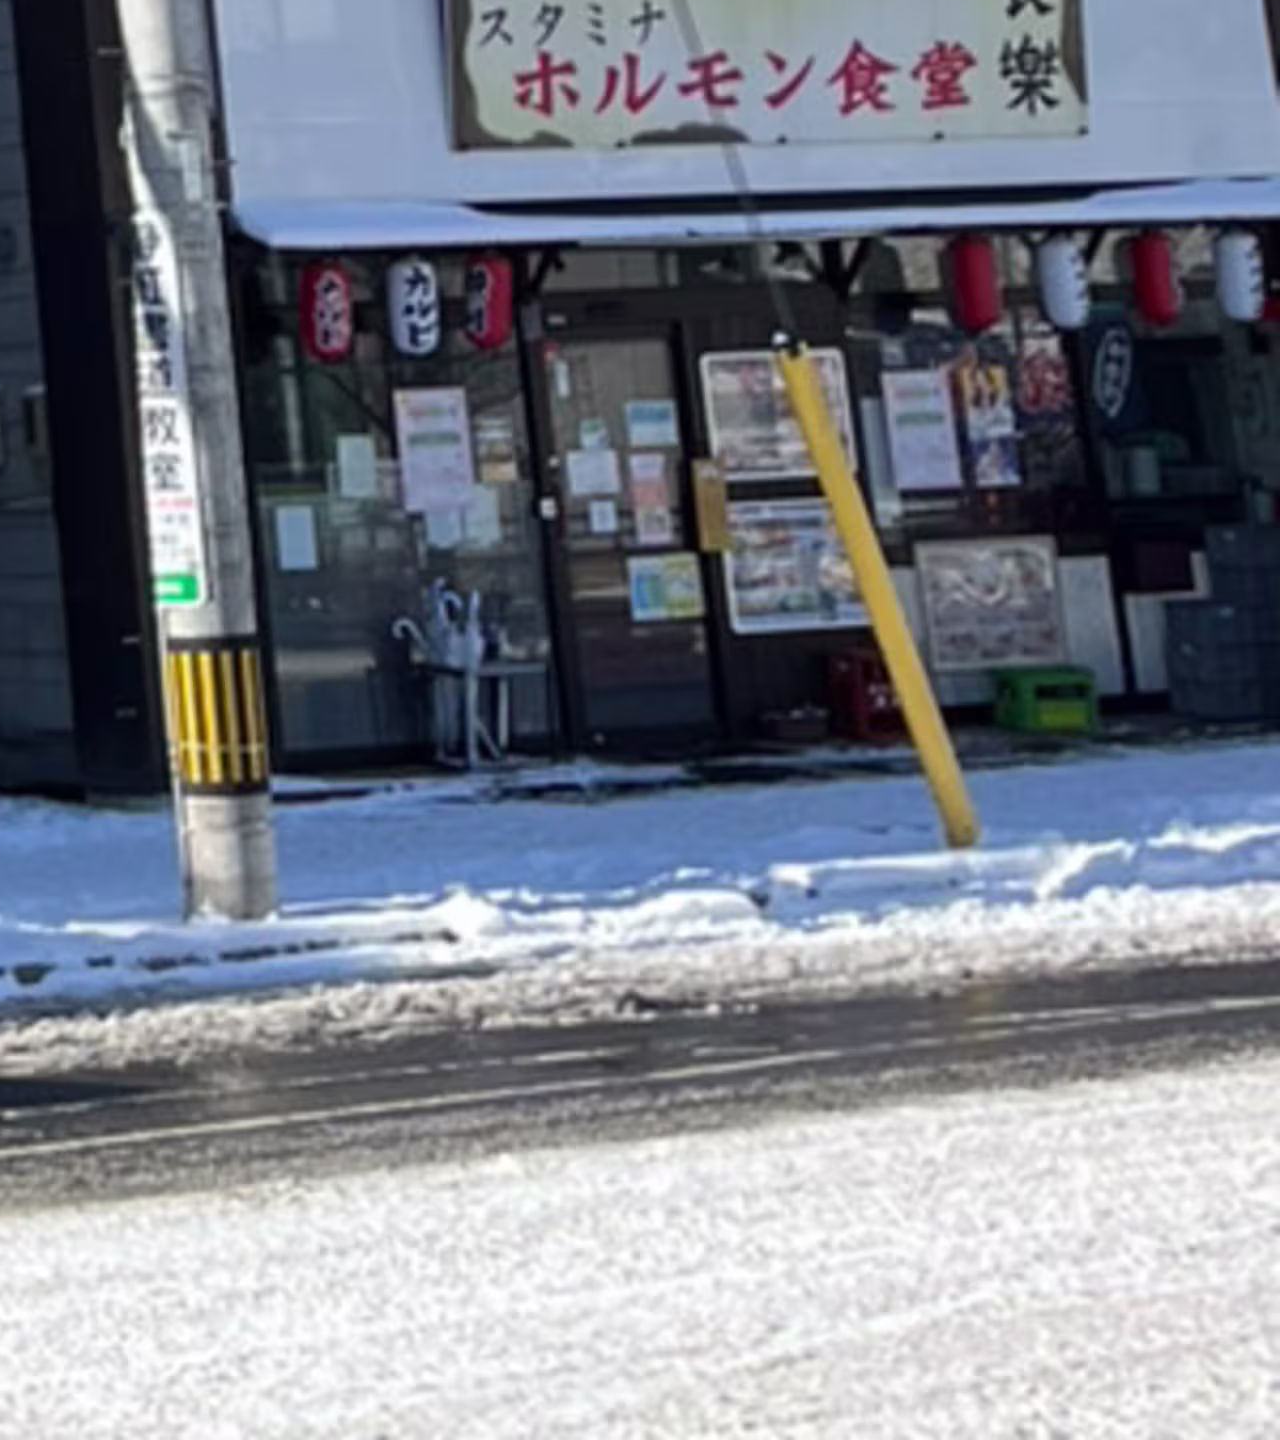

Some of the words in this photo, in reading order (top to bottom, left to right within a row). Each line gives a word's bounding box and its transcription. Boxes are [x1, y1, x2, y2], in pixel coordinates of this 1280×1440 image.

[477, 0, 667, 47] スタミナ
[513, 38, 978, 117] ホルモン食堂
[402, 266, 439, 347] カルビ
